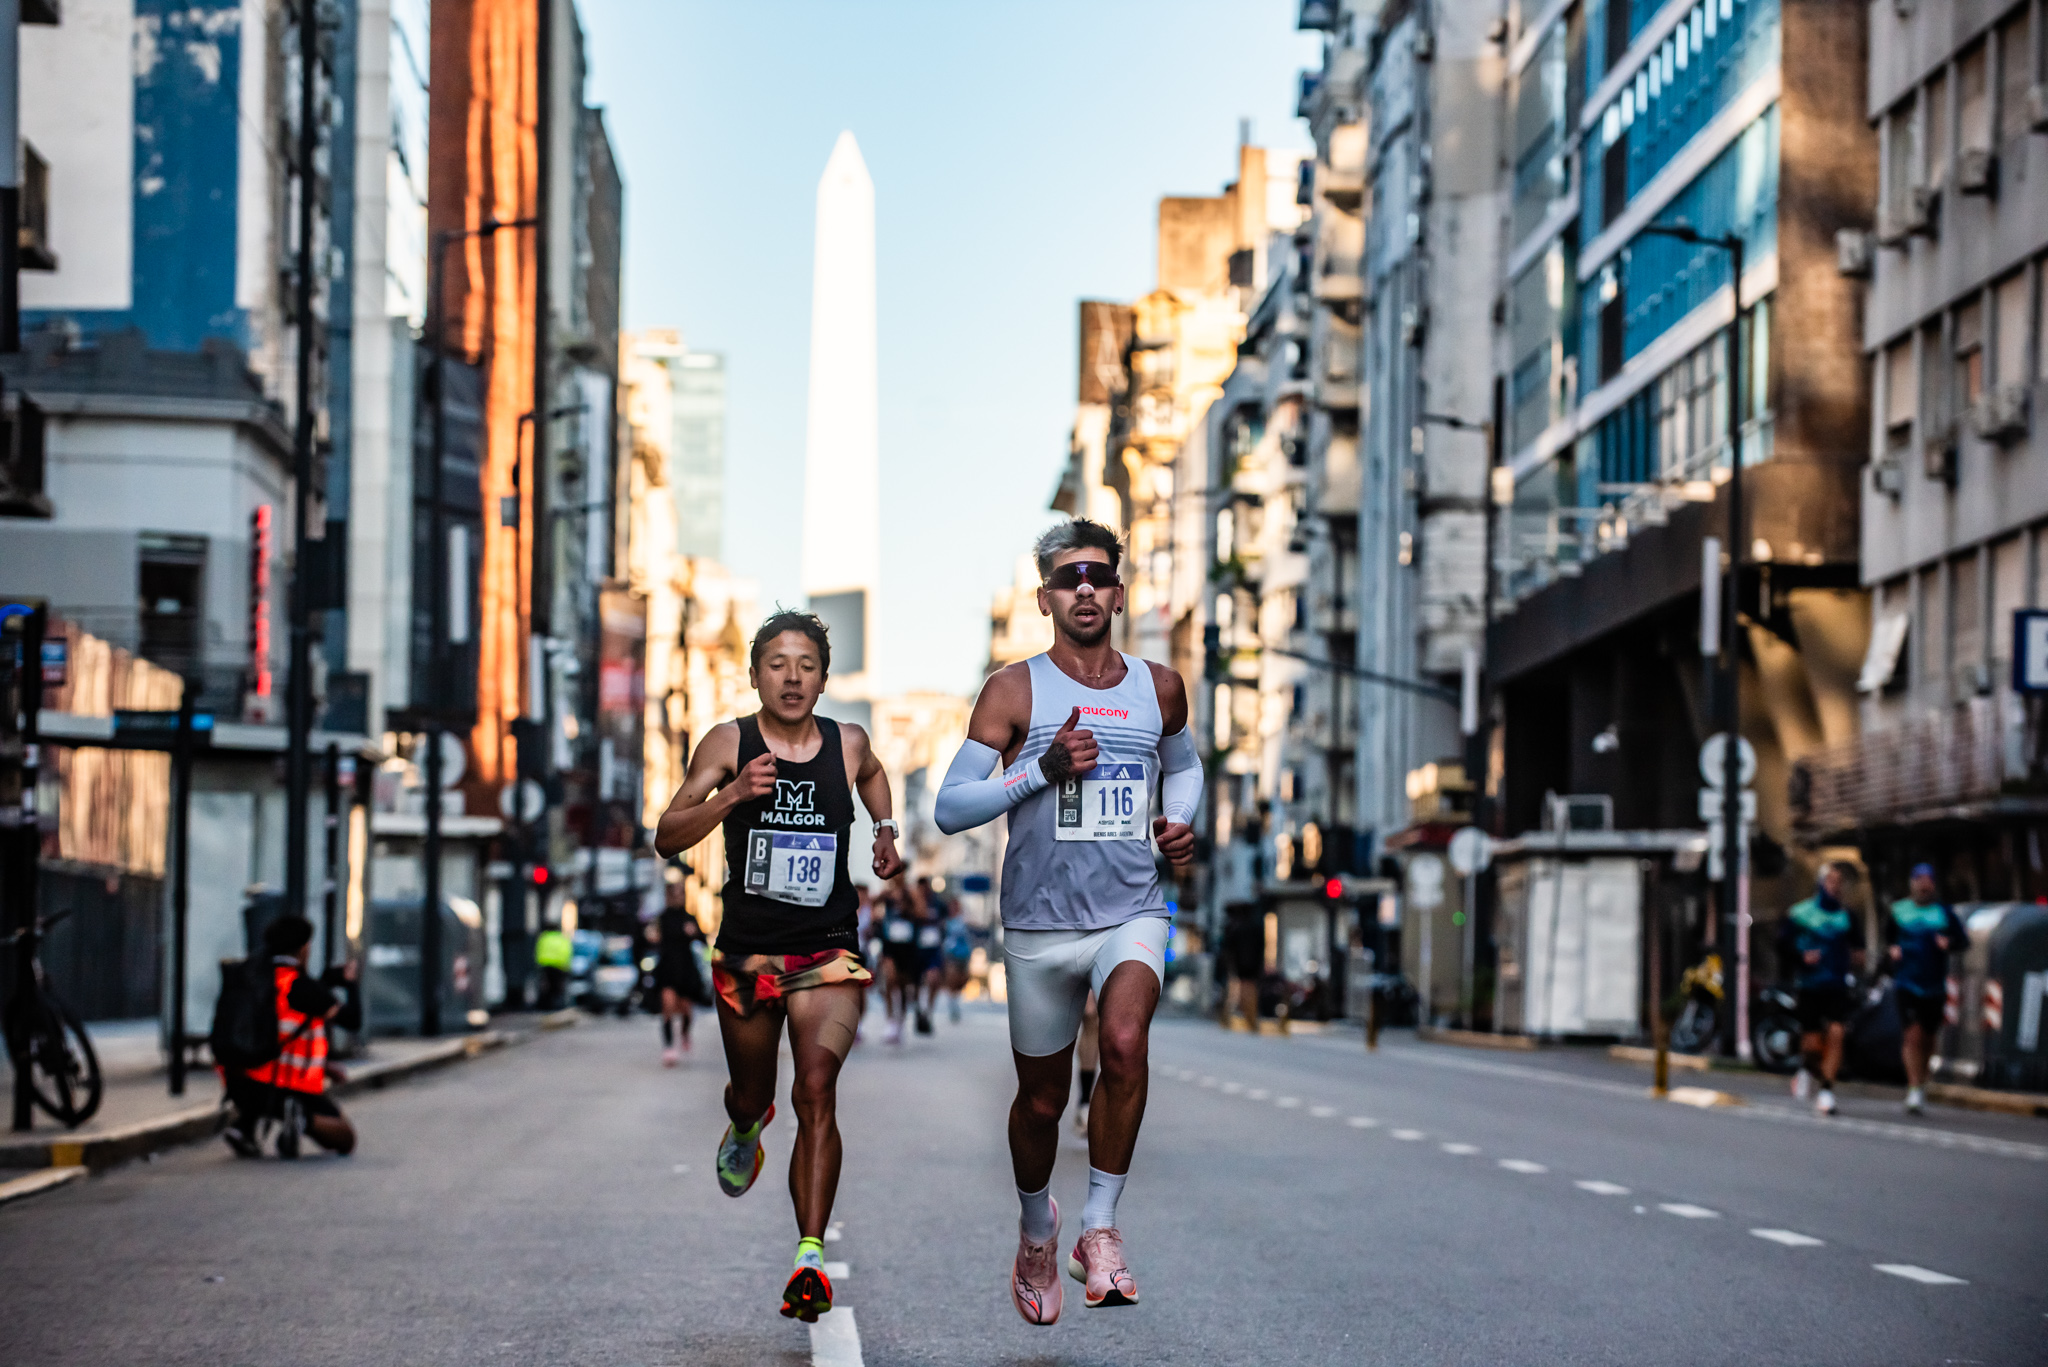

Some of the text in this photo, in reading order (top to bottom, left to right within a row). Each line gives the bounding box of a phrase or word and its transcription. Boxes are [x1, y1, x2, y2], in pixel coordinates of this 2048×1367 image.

[1077, 705, 1129, 720] saucony
[1003, 771, 1028, 788] saucony
[774, 778, 816, 812] M
[1098, 786, 1134, 817] 116
[760, 811, 826, 826] MALGOR
[755, 837, 767, 860] B
[787, 855, 822, 884] 138
